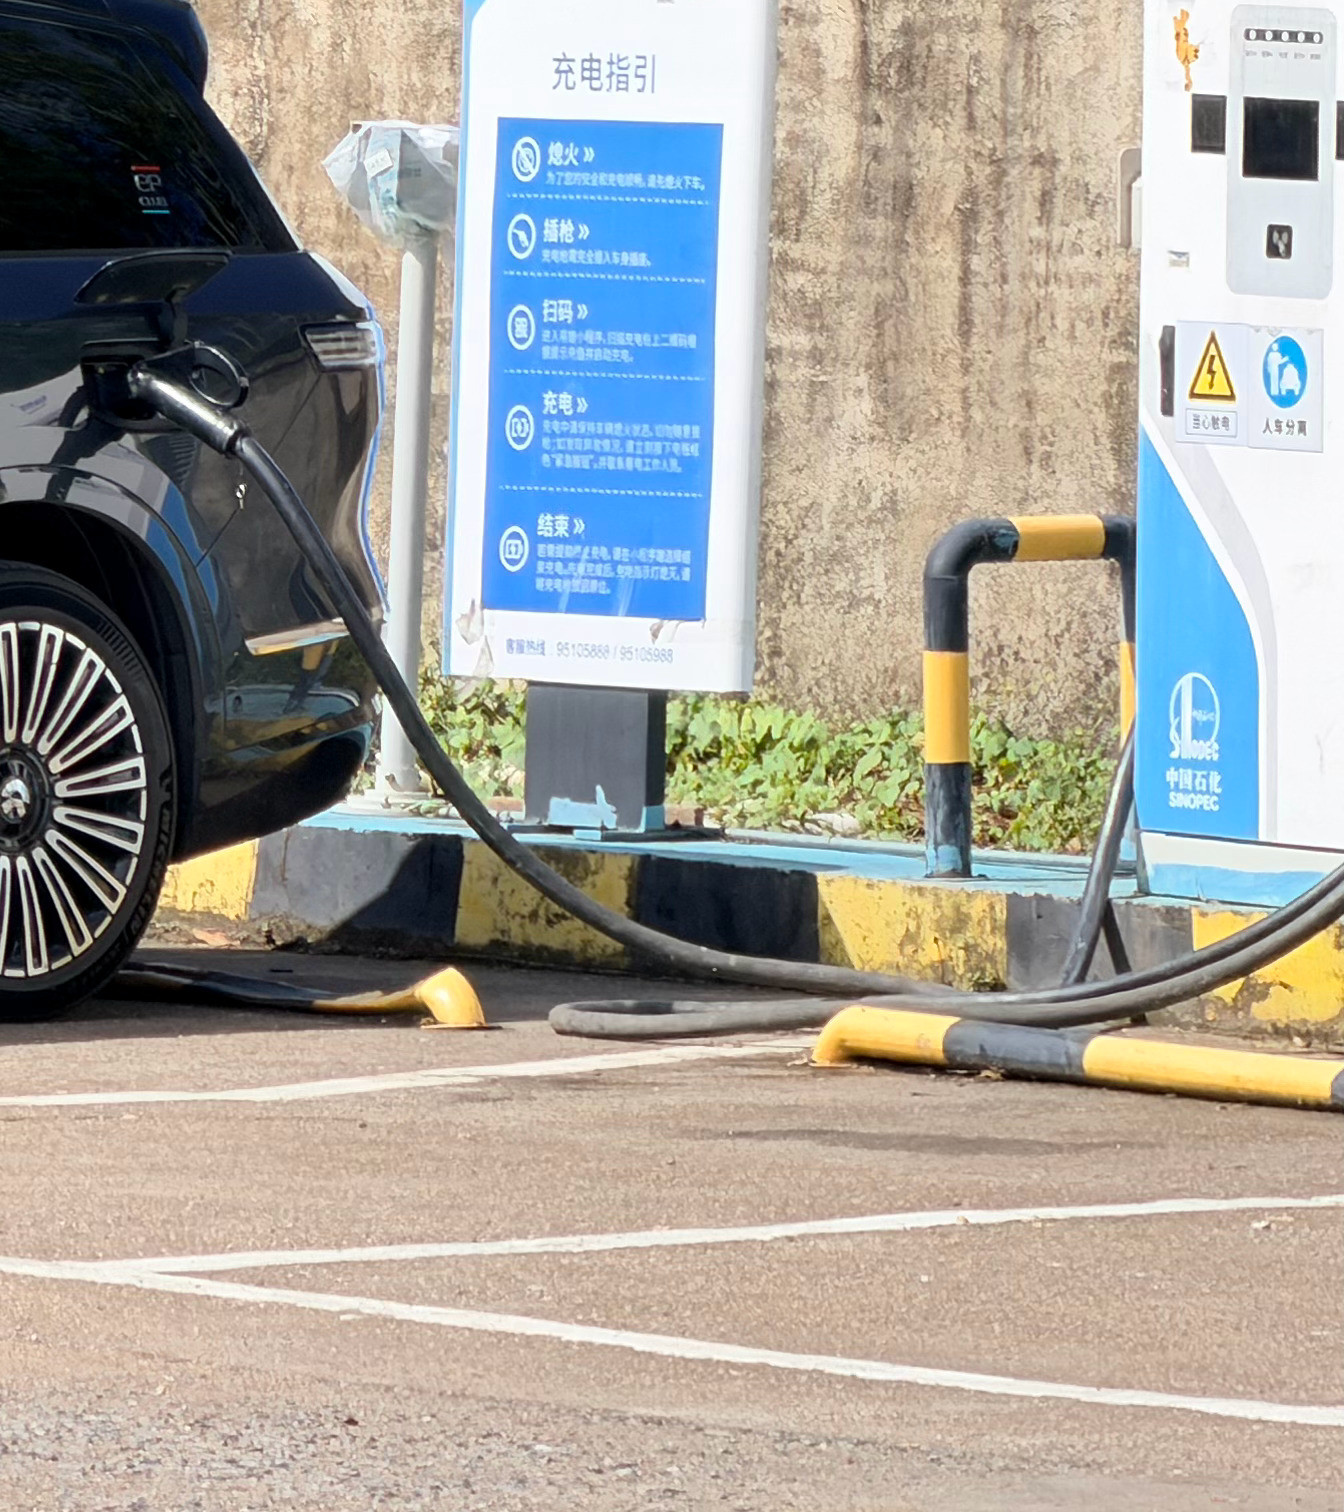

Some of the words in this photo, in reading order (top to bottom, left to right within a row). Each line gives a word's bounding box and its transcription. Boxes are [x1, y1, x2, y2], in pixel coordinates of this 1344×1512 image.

[552, 51, 655, 94] 充电指引
[548, 142, 579, 166] 熄火
[543, 219, 575, 243] 插枪
[542, 299, 573, 323] 扫码
[542, 390, 573, 416] 充电
[1262, 417, 1307, 436] 人车分离
[537, 513, 569, 538] 结束
[1166, 766, 1222, 793] 中国石化
[1169, 791, 1220, 812] SINOPEC
